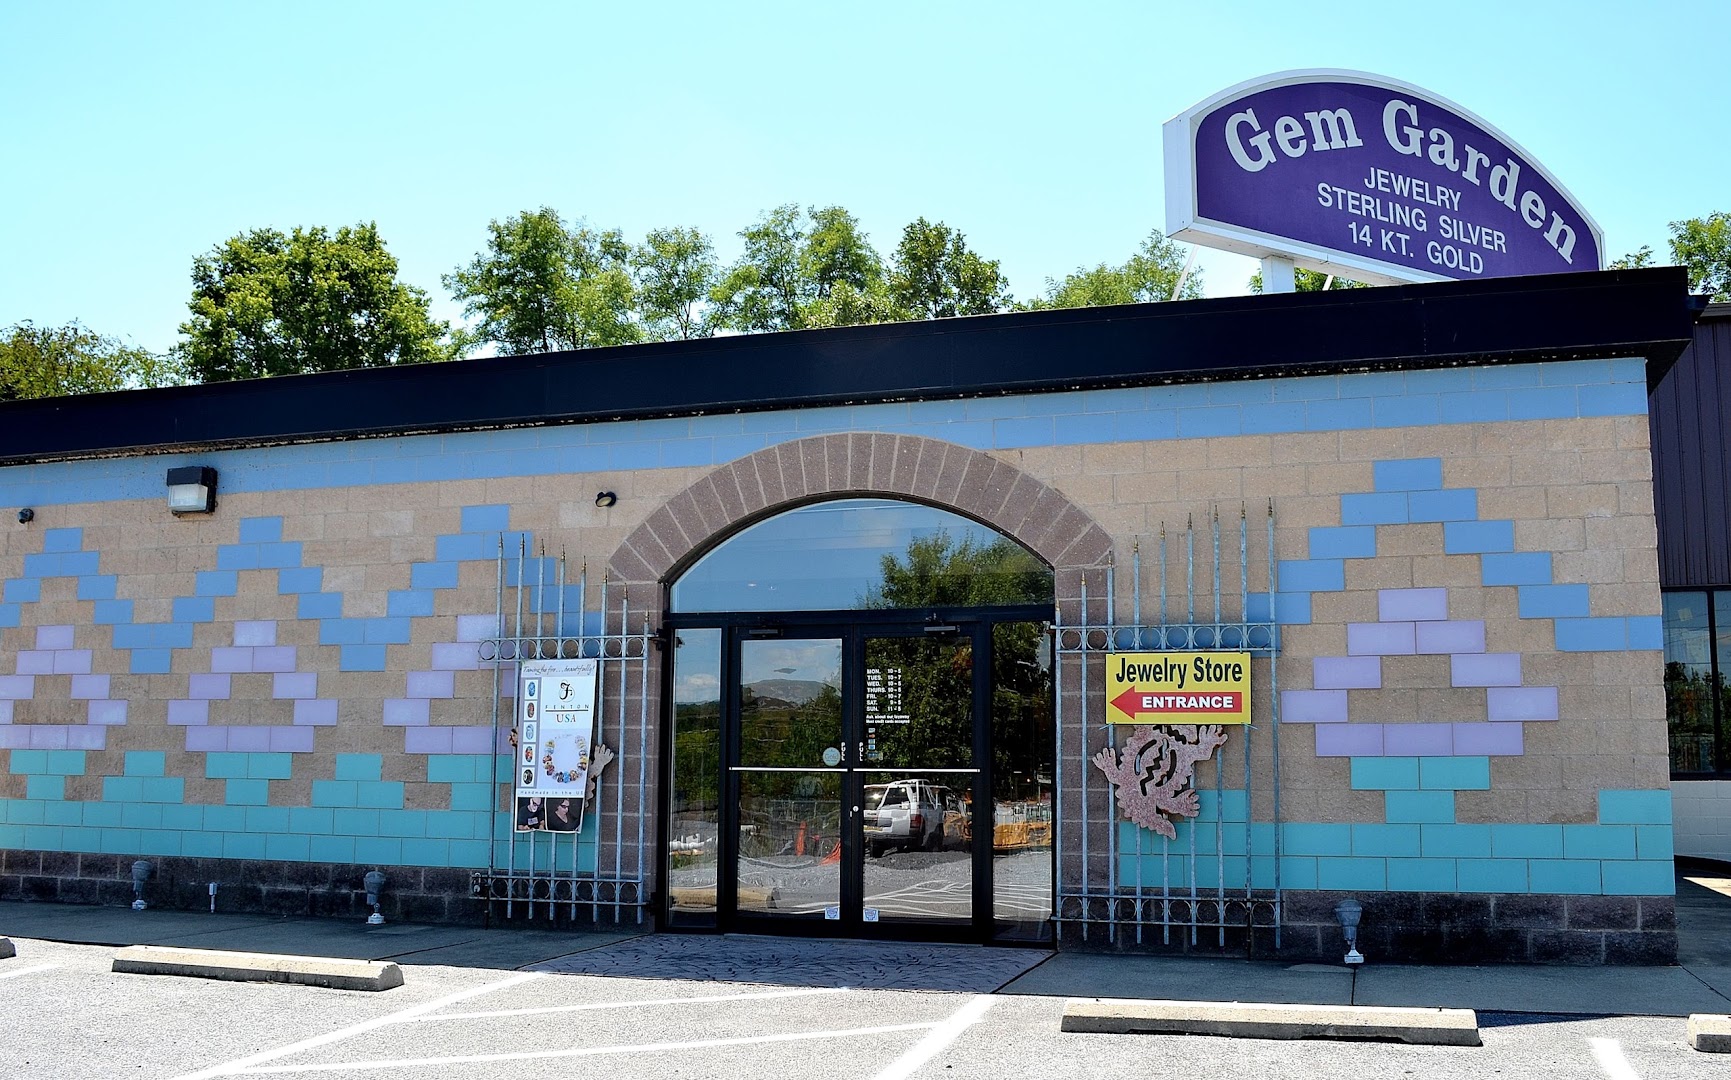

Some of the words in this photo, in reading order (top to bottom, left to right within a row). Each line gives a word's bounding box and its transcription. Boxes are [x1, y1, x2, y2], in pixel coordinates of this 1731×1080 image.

[1224, 107, 1363, 173] Gem
[1382, 99, 1579, 265] Garden
[1364, 166, 1462, 212] JEWELRY
[1317, 182, 1428, 232] STERLING
[1439, 215, 1507, 254] SILVER
[1347, 221, 1373, 248] 14
[1381, 231, 1414, 259] KT.
[1427, 243, 1484, 275] GOLD
[1115, 657, 1187, 689] Jewelry
[1193, 656, 1243, 683] Store
[556, 714, 576, 723] USA
[1142, 696, 1233, 708] ENTRANCE
